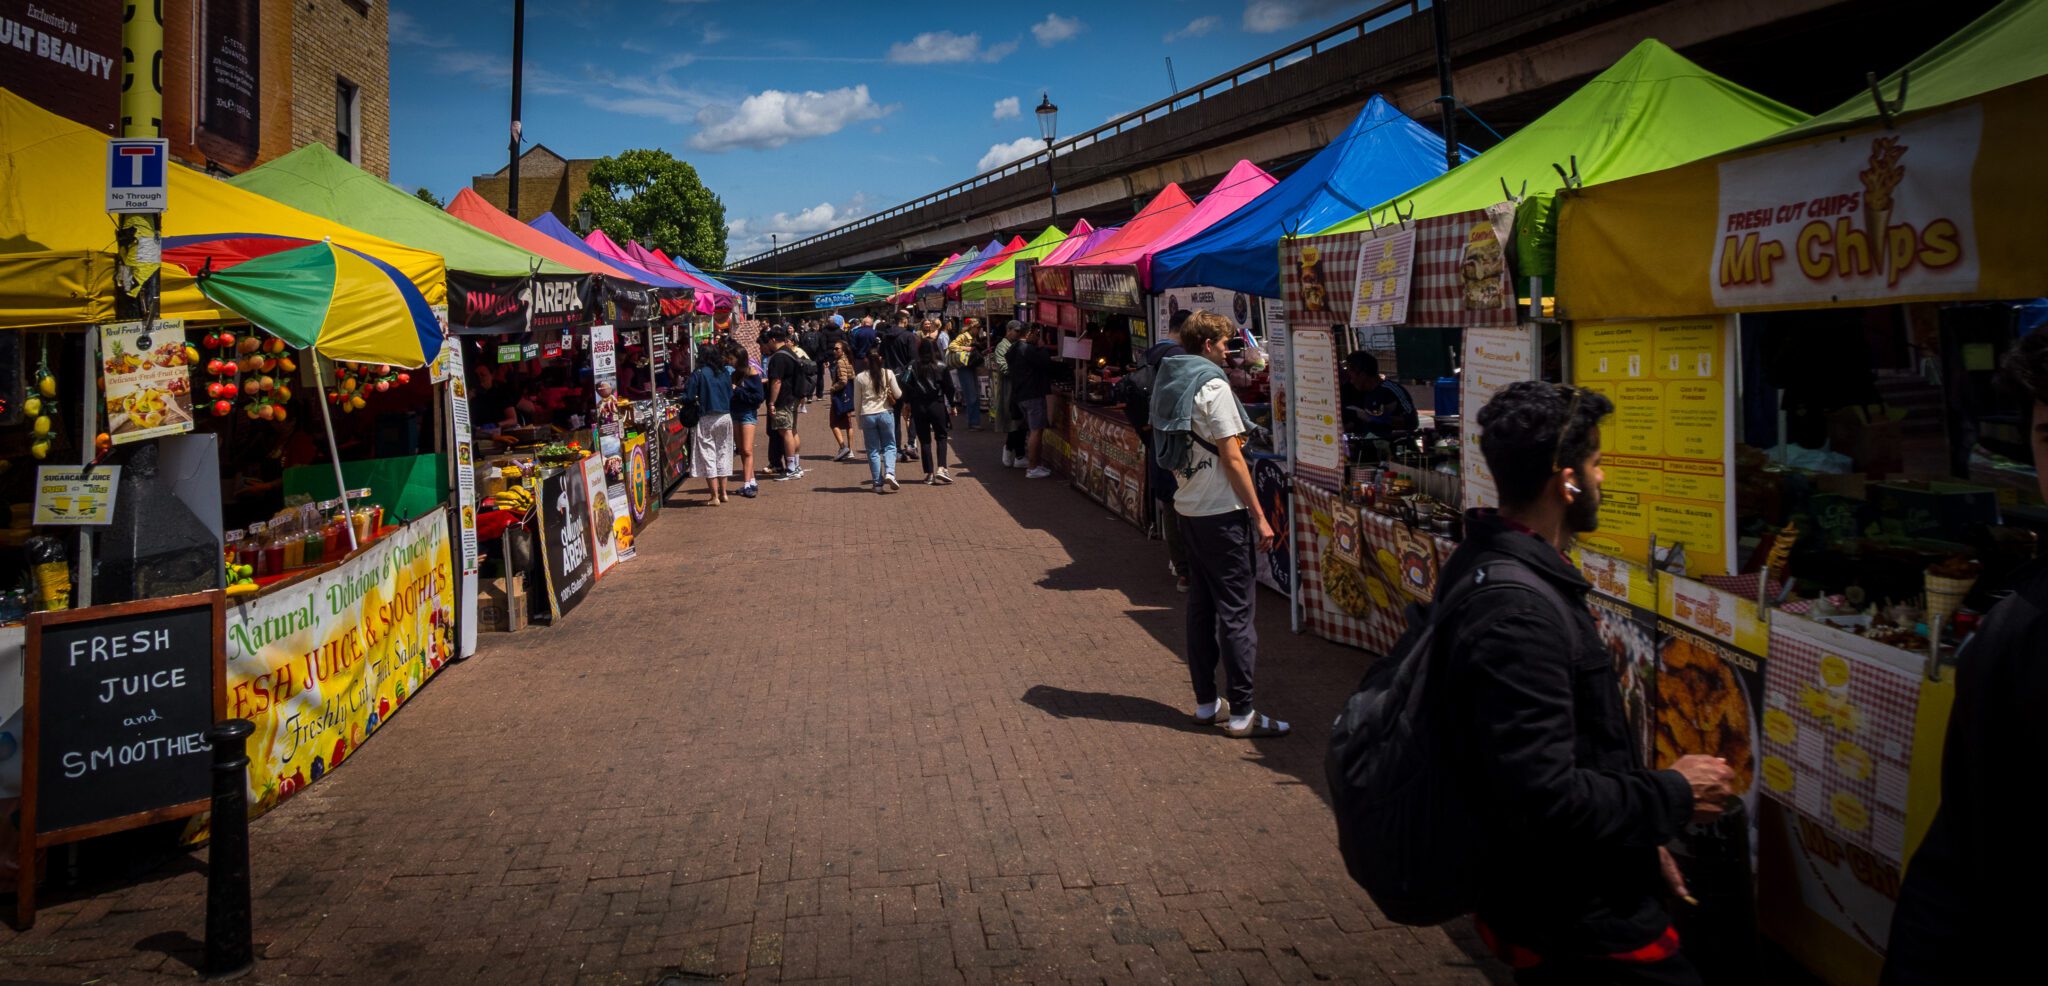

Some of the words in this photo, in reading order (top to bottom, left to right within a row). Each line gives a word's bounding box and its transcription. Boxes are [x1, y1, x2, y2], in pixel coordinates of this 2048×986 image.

[27, 3, 69, 33] Exclusively
[37, 31, 114, 80] BEAUTY
[126, 192, 162, 201] Through
[1727, 207, 1773, 232] FRESH
[1776, 202, 1807, 224] CUT
[1806, 191, 1861, 218] CHIPS
[1719, 231, 1785, 288] Mr
[1796, 216, 1962, 289] Chips
[535, 281, 584, 314] AREPA
[110, 376, 137, 384] Delicious
[230, 593, 320, 660] Natural,
[326, 555, 379, 615] Delicious
[70, 629, 170, 666] FRESH
[303, 626, 363, 691] JUICE
[365, 615, 378, 648] &
[98, 667, 186, 703] JUICE
[123, 708, 163, 726] and
[282, 694, 347, 764] Freshly
[348, 677, 368, 713] Cut
[62, 732, 213, 778] SMOOTHIES
